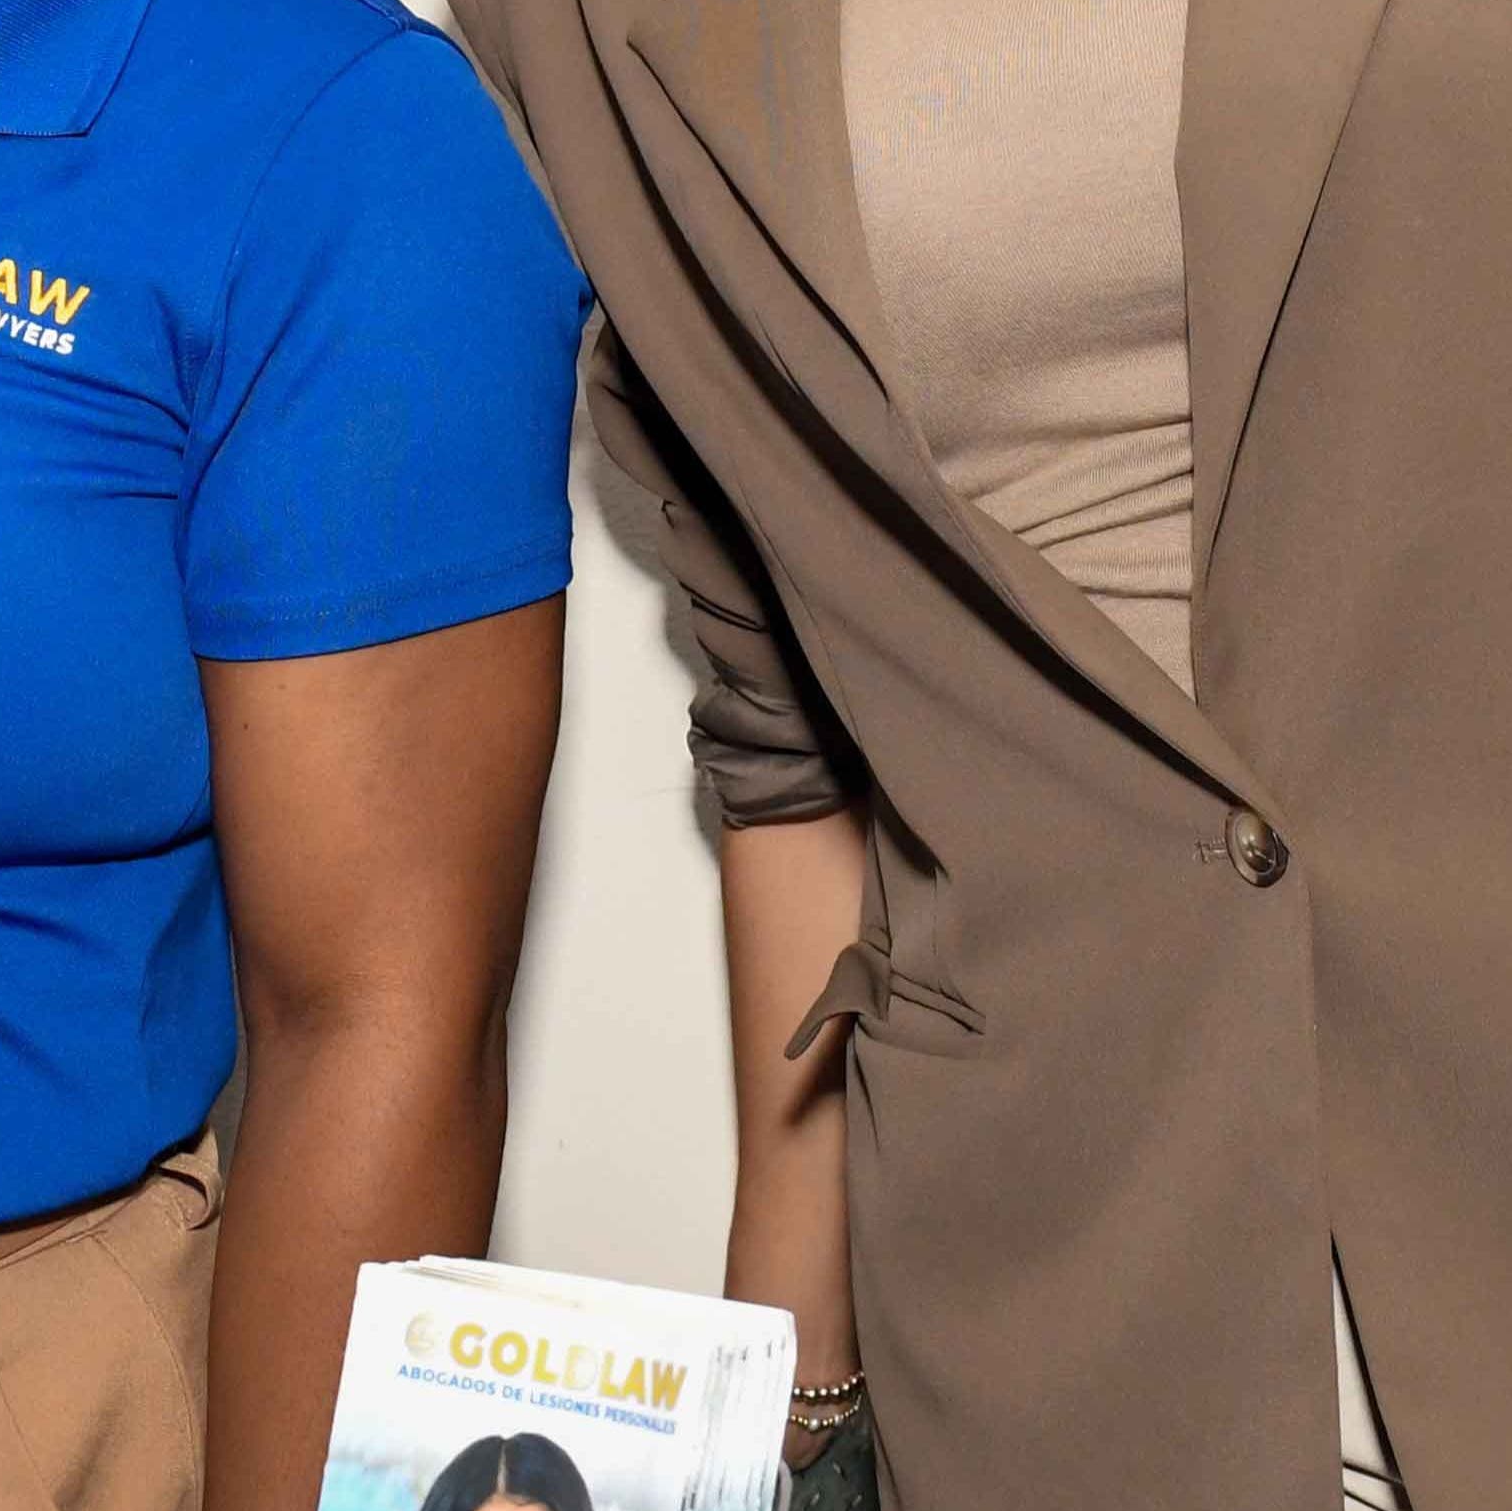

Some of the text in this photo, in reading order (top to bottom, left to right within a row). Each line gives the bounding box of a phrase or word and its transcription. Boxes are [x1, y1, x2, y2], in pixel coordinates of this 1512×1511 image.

[397, 1364, 676, 1436] ABOGADOS DE LESIONES PERSONALES
[450, 1323, 688, 1412] GOLDLAW
